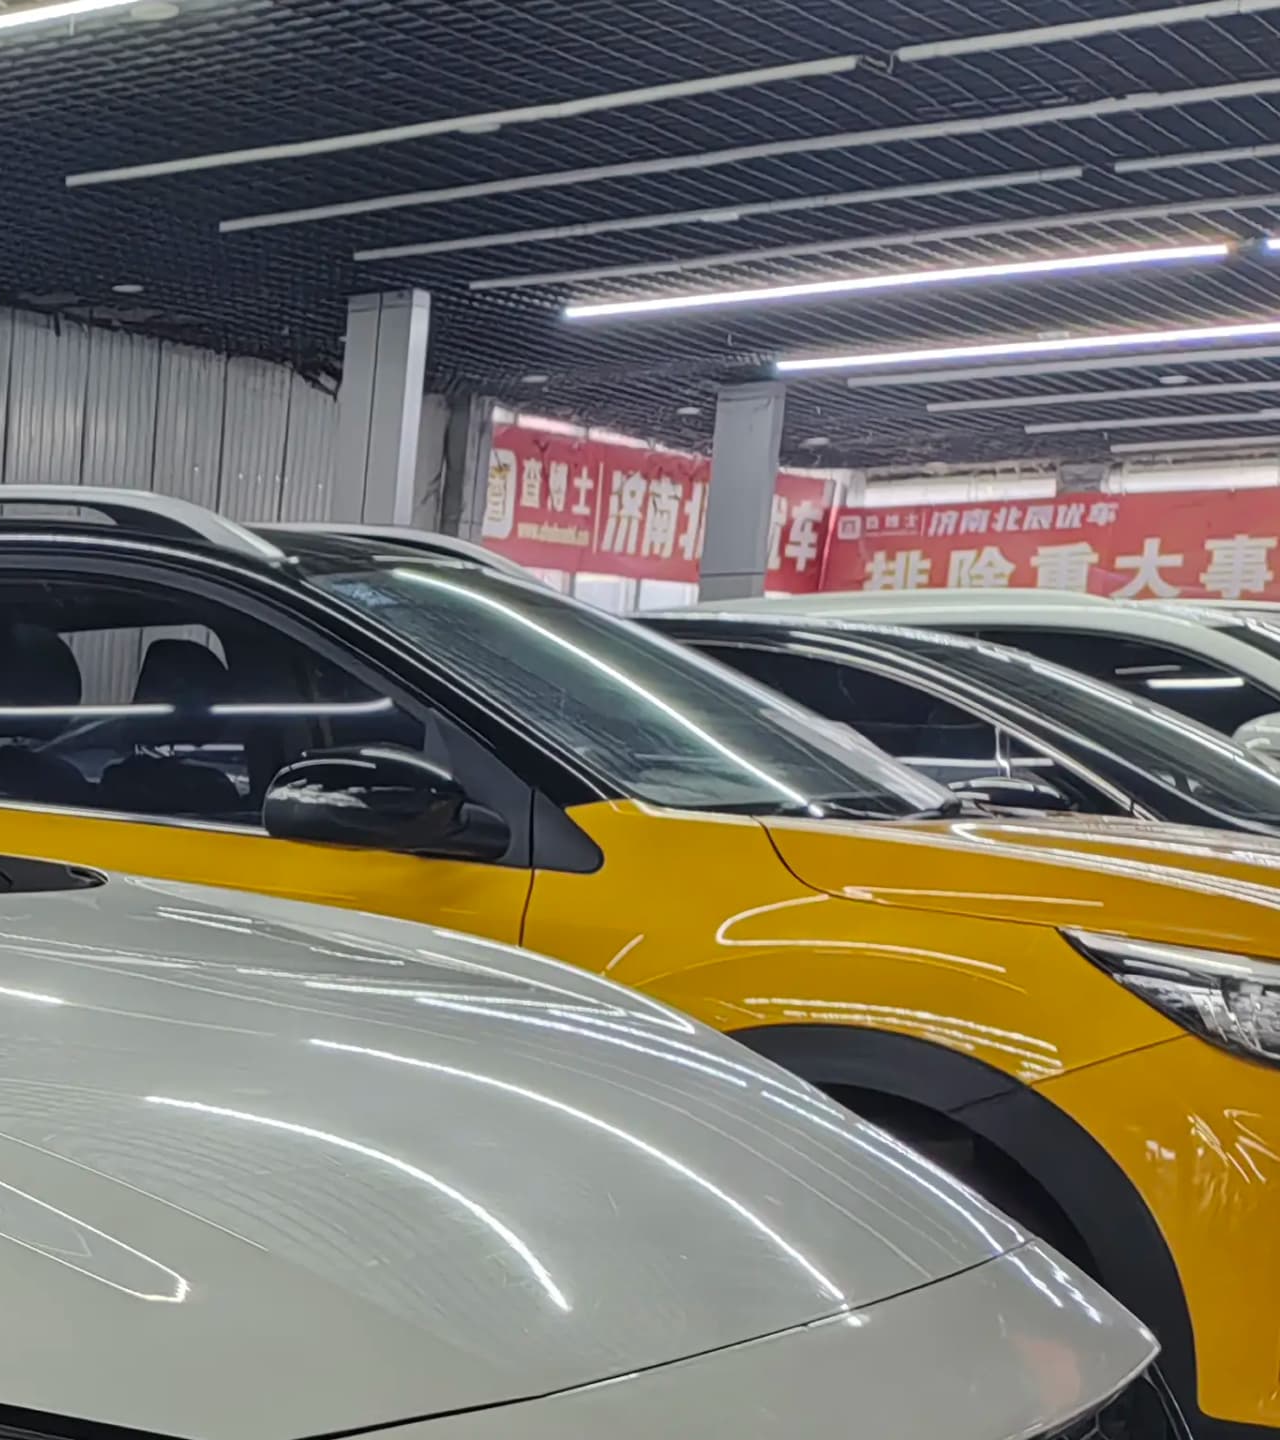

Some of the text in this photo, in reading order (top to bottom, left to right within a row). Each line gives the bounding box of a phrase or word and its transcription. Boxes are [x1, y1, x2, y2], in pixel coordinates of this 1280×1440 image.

[863, 534, 1278, 599] 排除重大事
